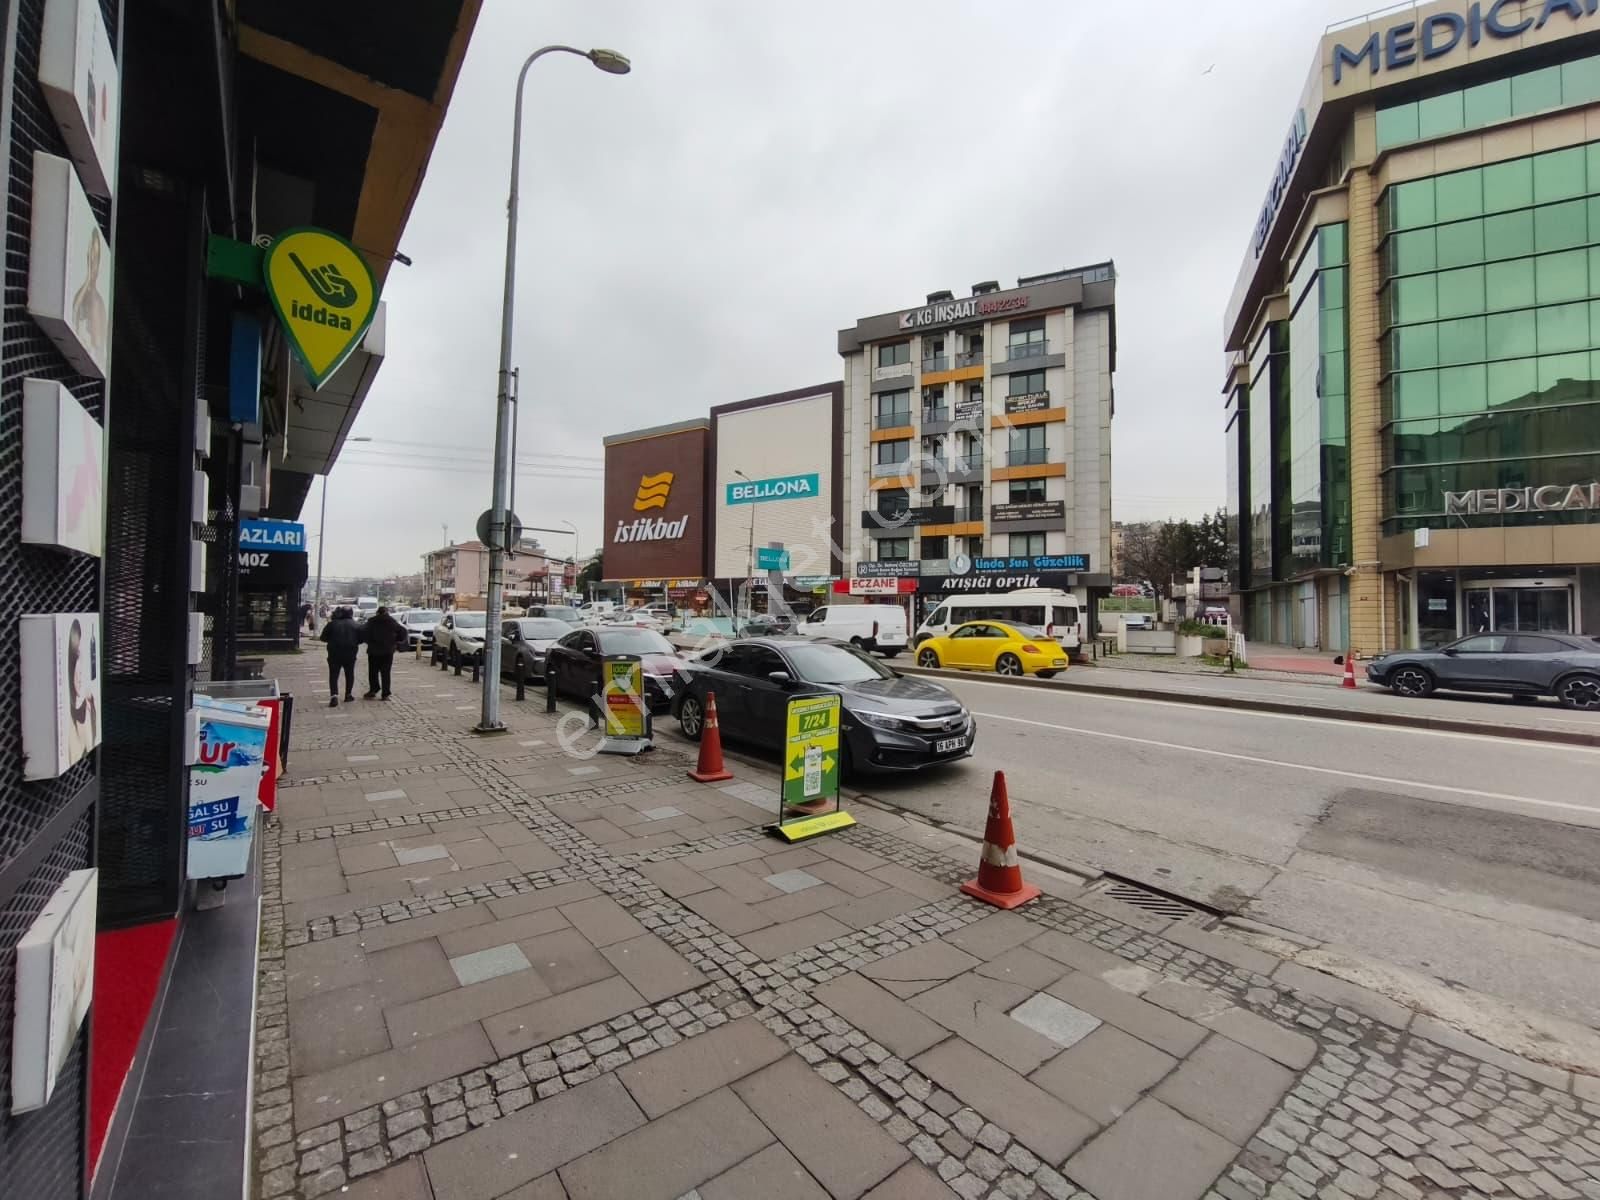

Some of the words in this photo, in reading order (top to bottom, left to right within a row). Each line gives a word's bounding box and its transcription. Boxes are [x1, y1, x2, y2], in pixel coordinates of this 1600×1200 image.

[1333, 0, 1600, 86] MEDICA
[291, 300, 352, 331] iddaa
[917, 311, 932, 326] KG
[935, 300, 977, 325] İNŞAAT
[732, 478, 811, 501] BELLONA
[613, 514, 689, 544] istikbal
[975, 558, 1005, 569] Linda
[1009, 558, 1029, 568] Sun
[1033, 555, 1084, 567] Güzellik
[851, 578, 895, 588] ECZANE
[941, 576, 992, 591] AYIŞIĞI
[996, 575, 1040, 588] OPTİK
[803, 713, 826, 729] 7/24
[212, 801, 229, 814] SU
[211, 818, 228, 831] SU
